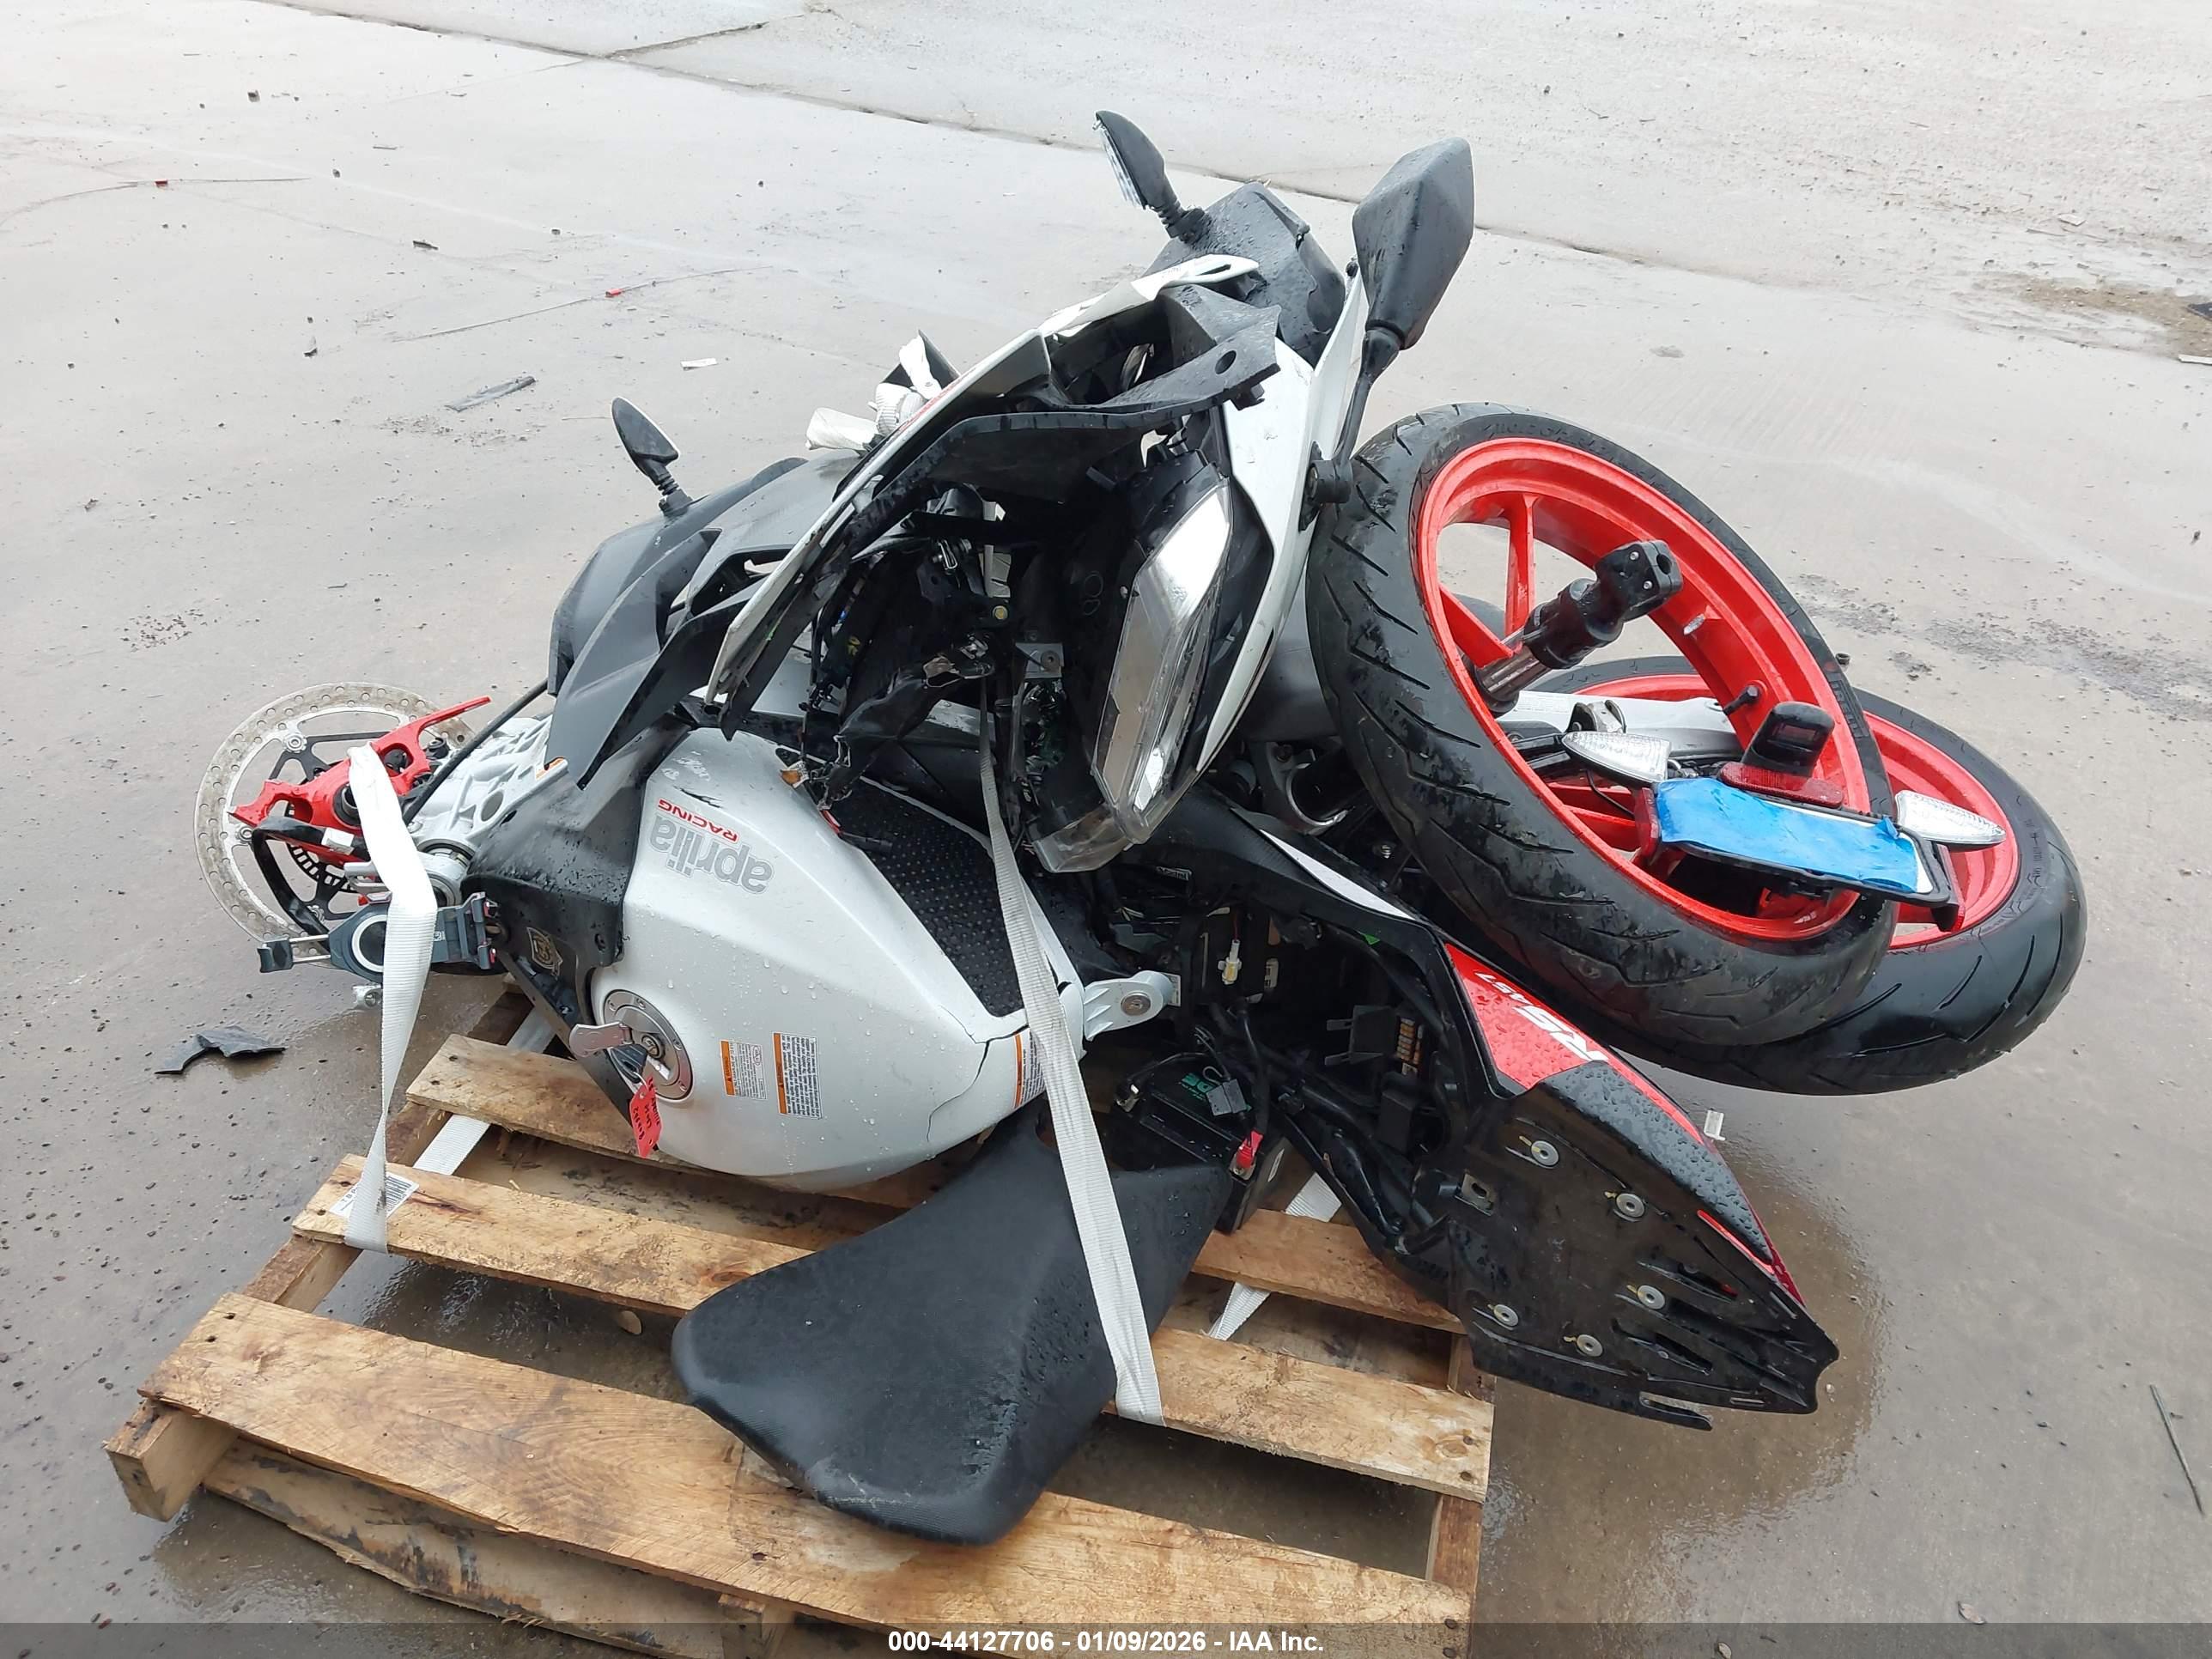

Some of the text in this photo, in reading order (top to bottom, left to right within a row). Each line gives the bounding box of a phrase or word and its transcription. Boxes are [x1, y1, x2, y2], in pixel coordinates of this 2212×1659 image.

[651, 817, 772, 893] aprilia
[658, 799, 738, 842] RACING
[1474, 972, 1608, 1060] RS 457
